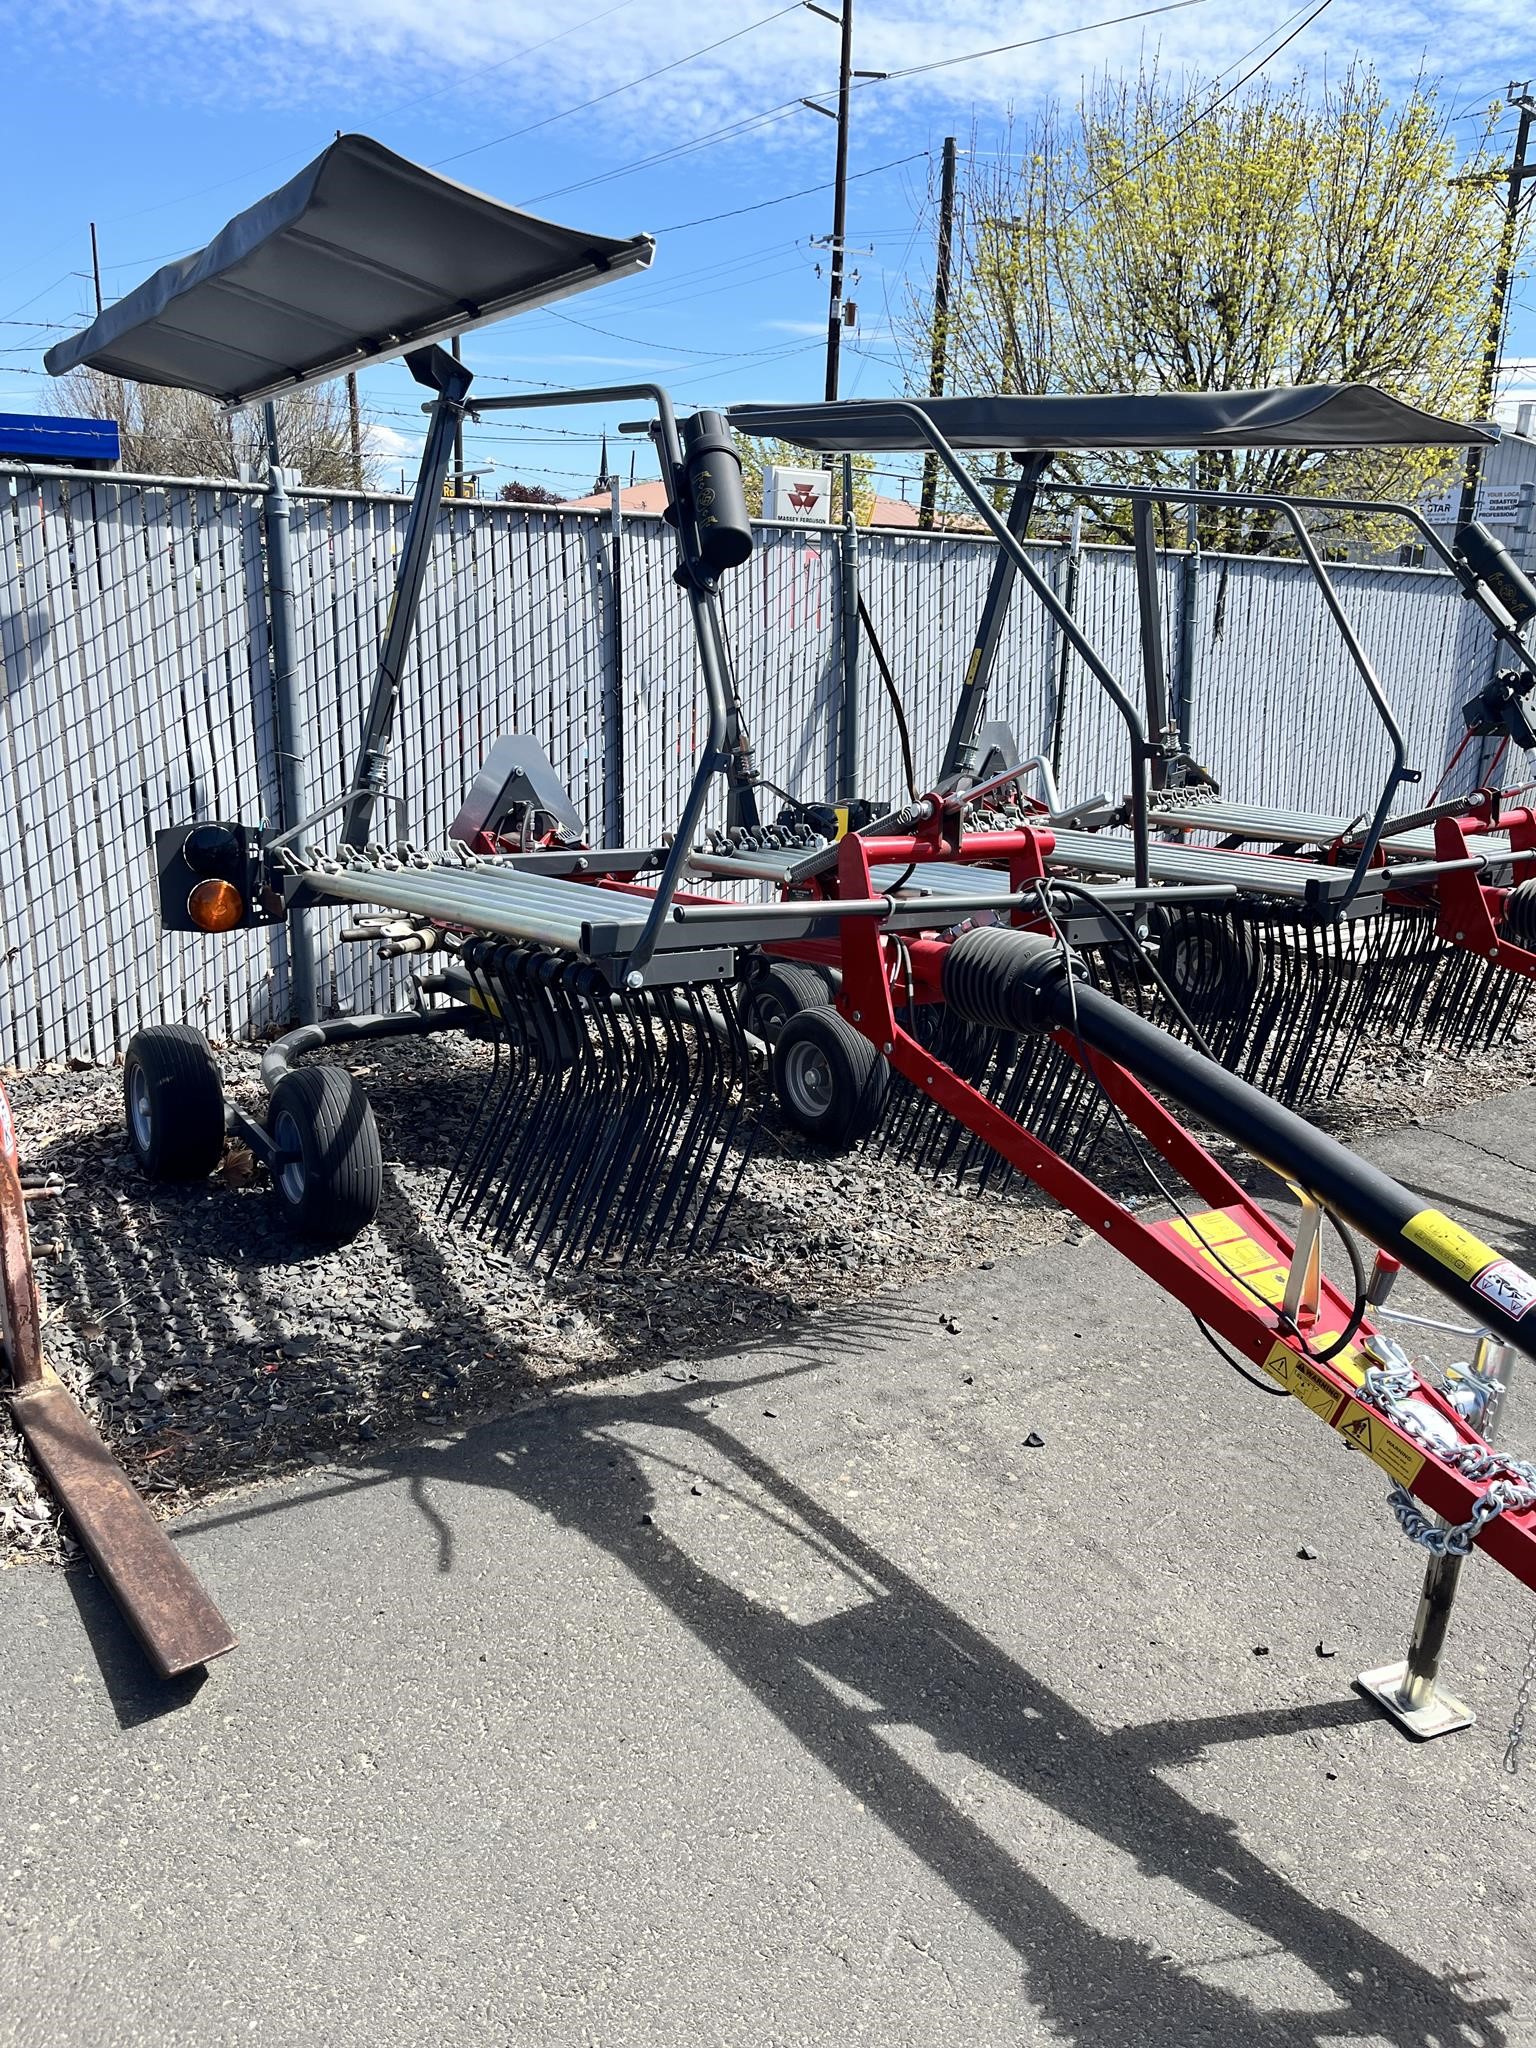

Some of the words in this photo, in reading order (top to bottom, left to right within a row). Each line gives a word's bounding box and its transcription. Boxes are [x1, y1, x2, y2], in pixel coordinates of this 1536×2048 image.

[1427, 503, 1451, 513] STAR
[1305, 1367, 1339, 1400] WARNING
[1386, 1439, 1413, 1462] WARNING
